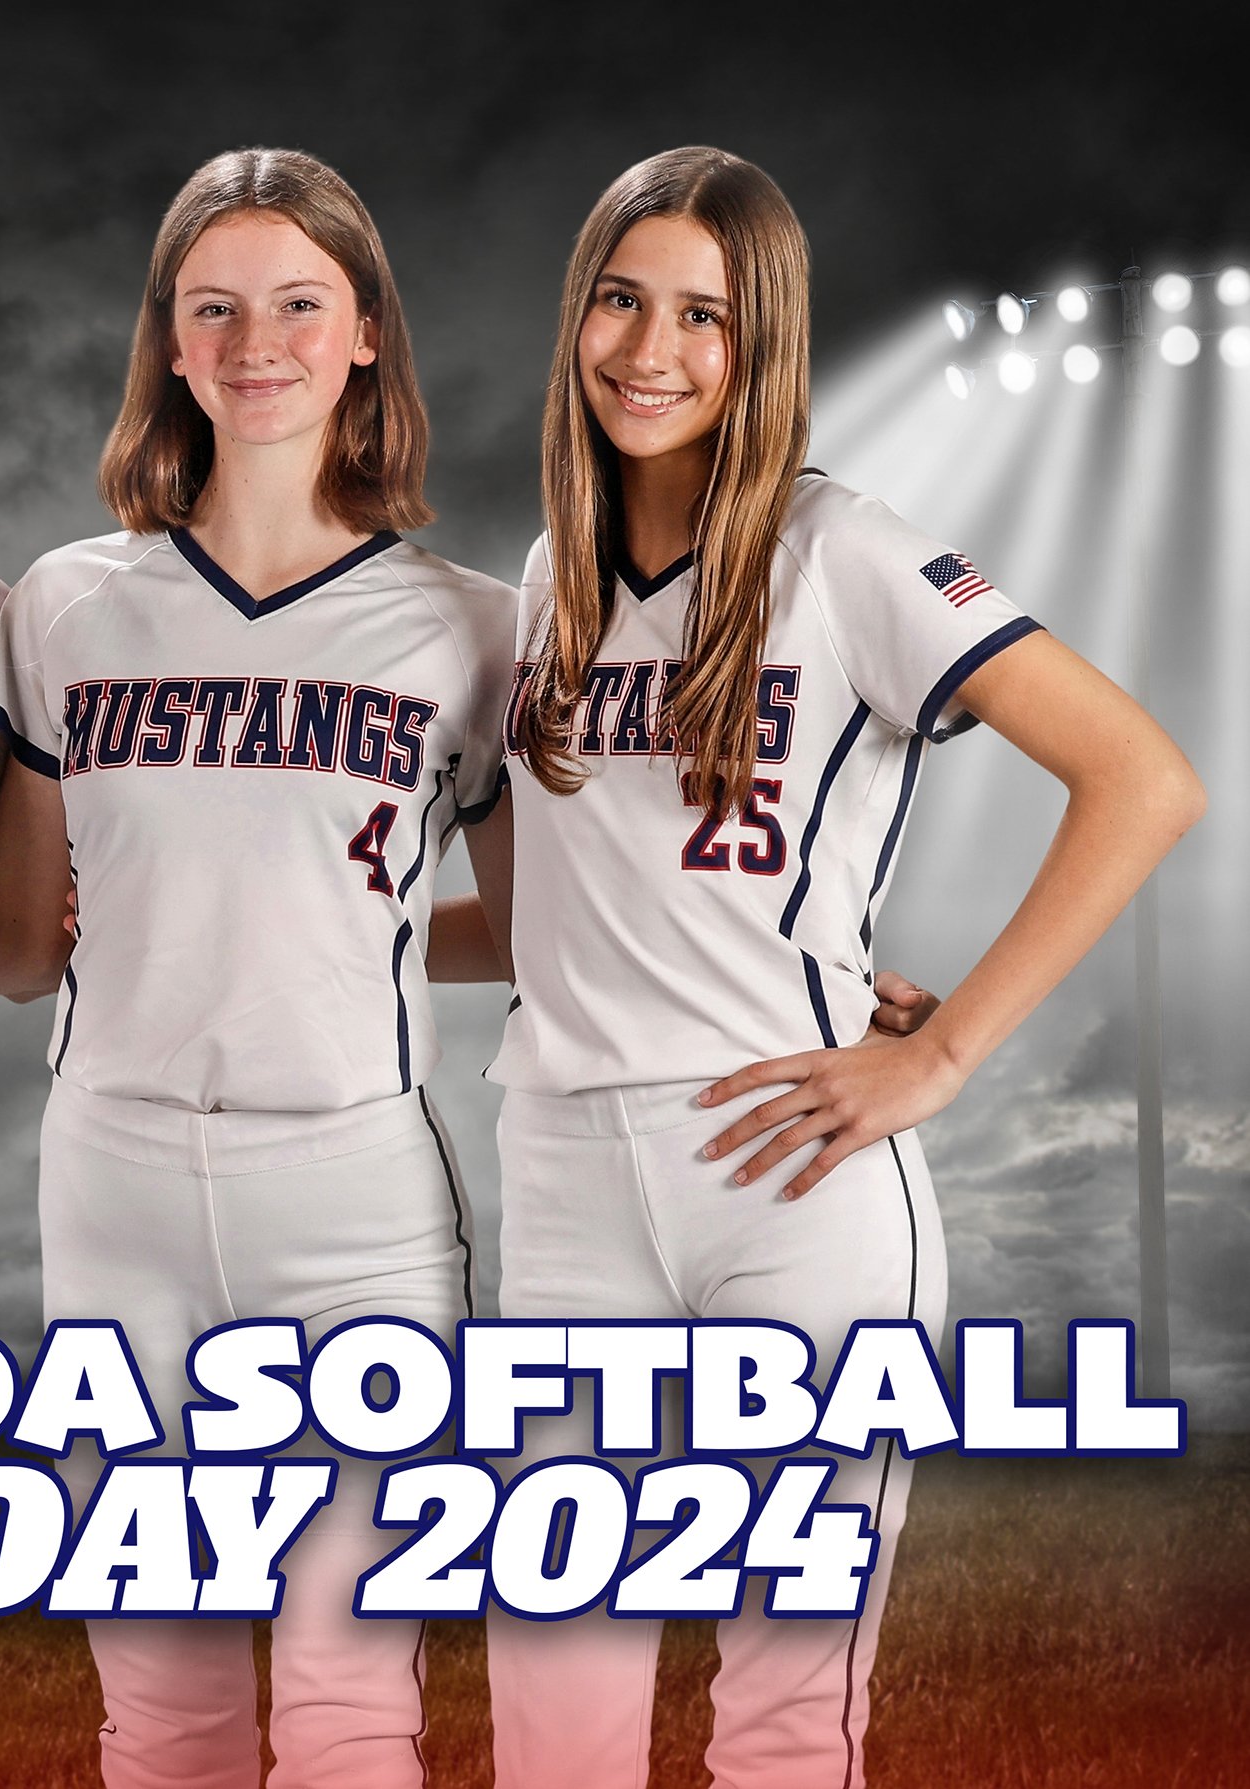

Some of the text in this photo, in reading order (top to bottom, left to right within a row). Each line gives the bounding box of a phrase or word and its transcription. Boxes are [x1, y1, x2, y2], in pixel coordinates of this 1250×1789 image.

[62, 677, 440, 793] MUSTANGS
[348, 800, 399, 899] 4
[680, 770, 787, 876] 25
